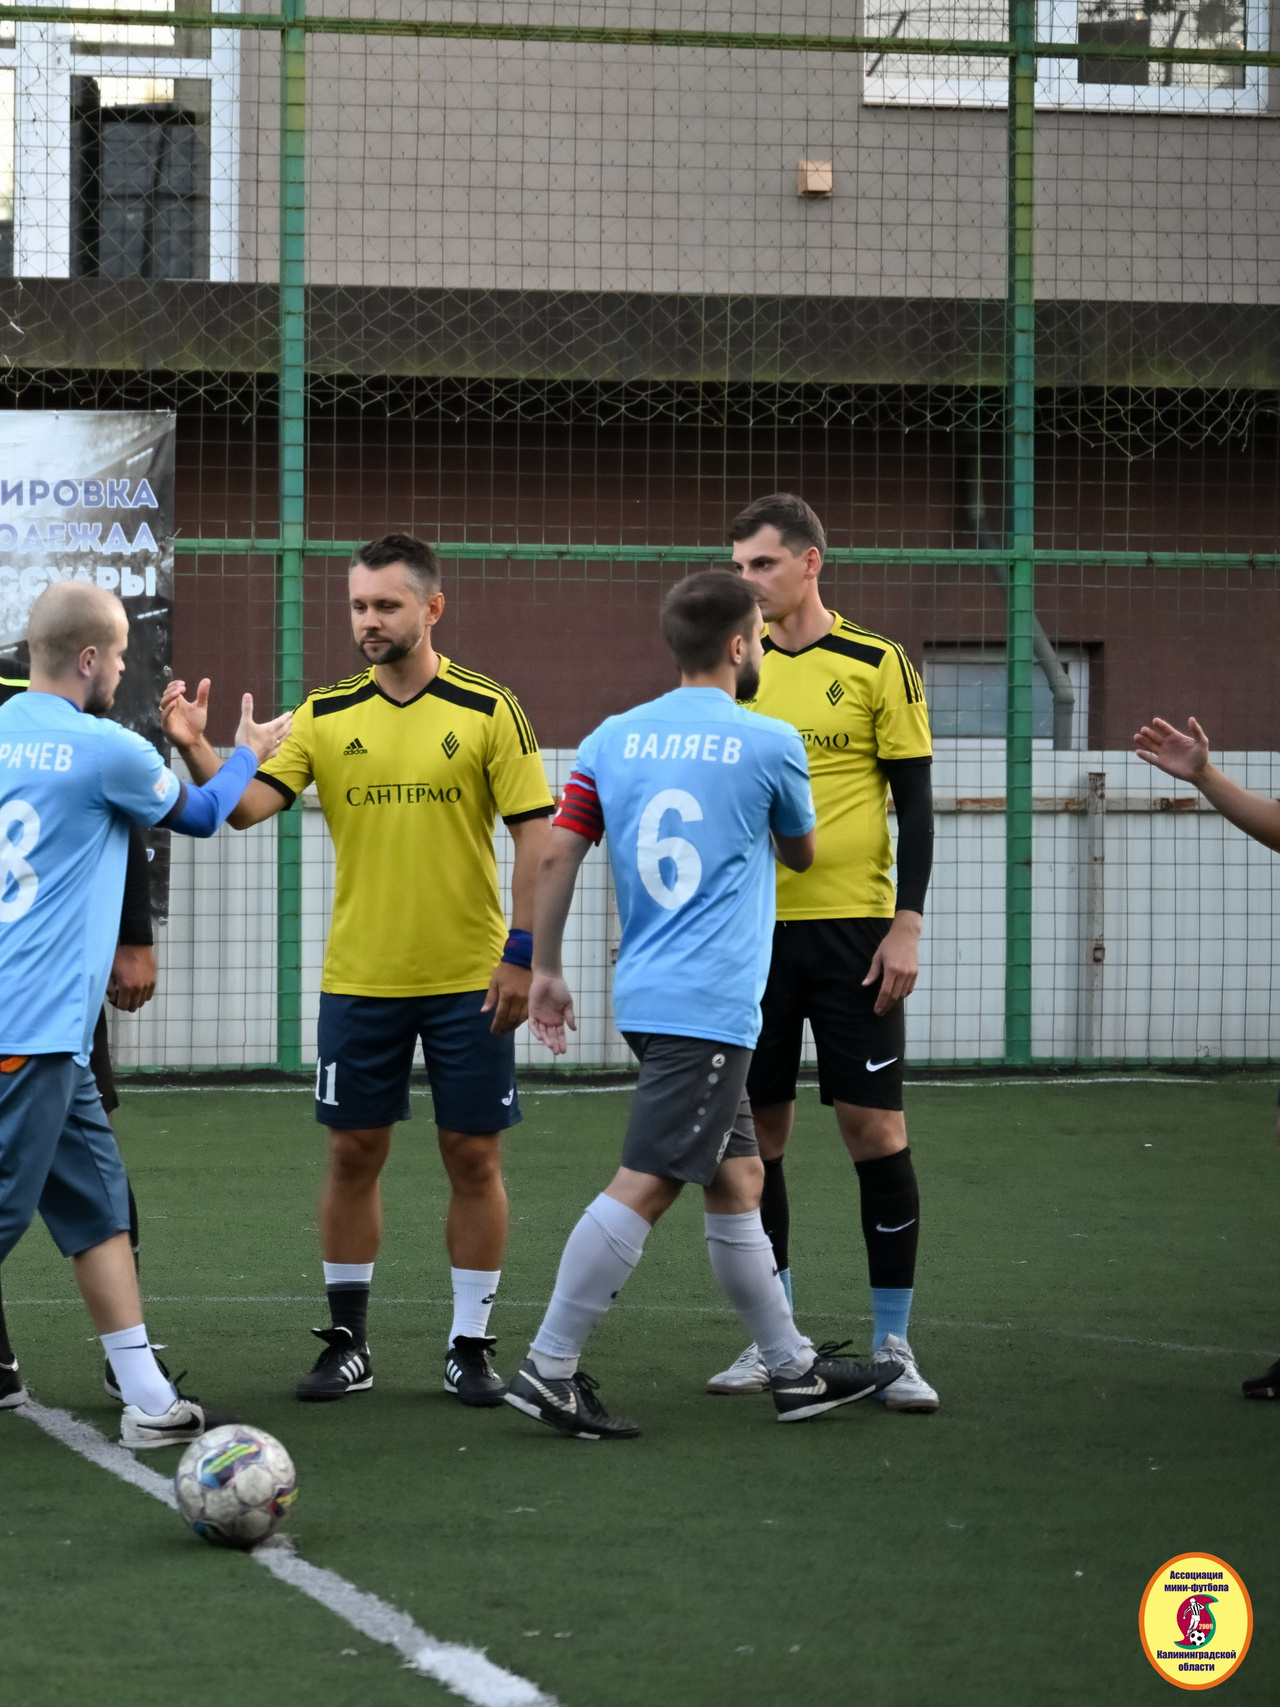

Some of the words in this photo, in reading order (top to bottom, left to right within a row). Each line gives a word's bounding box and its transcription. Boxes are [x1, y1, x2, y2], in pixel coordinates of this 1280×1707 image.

[343, 748, 368, 756] adidas
[623, 733, 742, 765] ВАЛЯЕВ
[636, 788, 704, 911] 6
